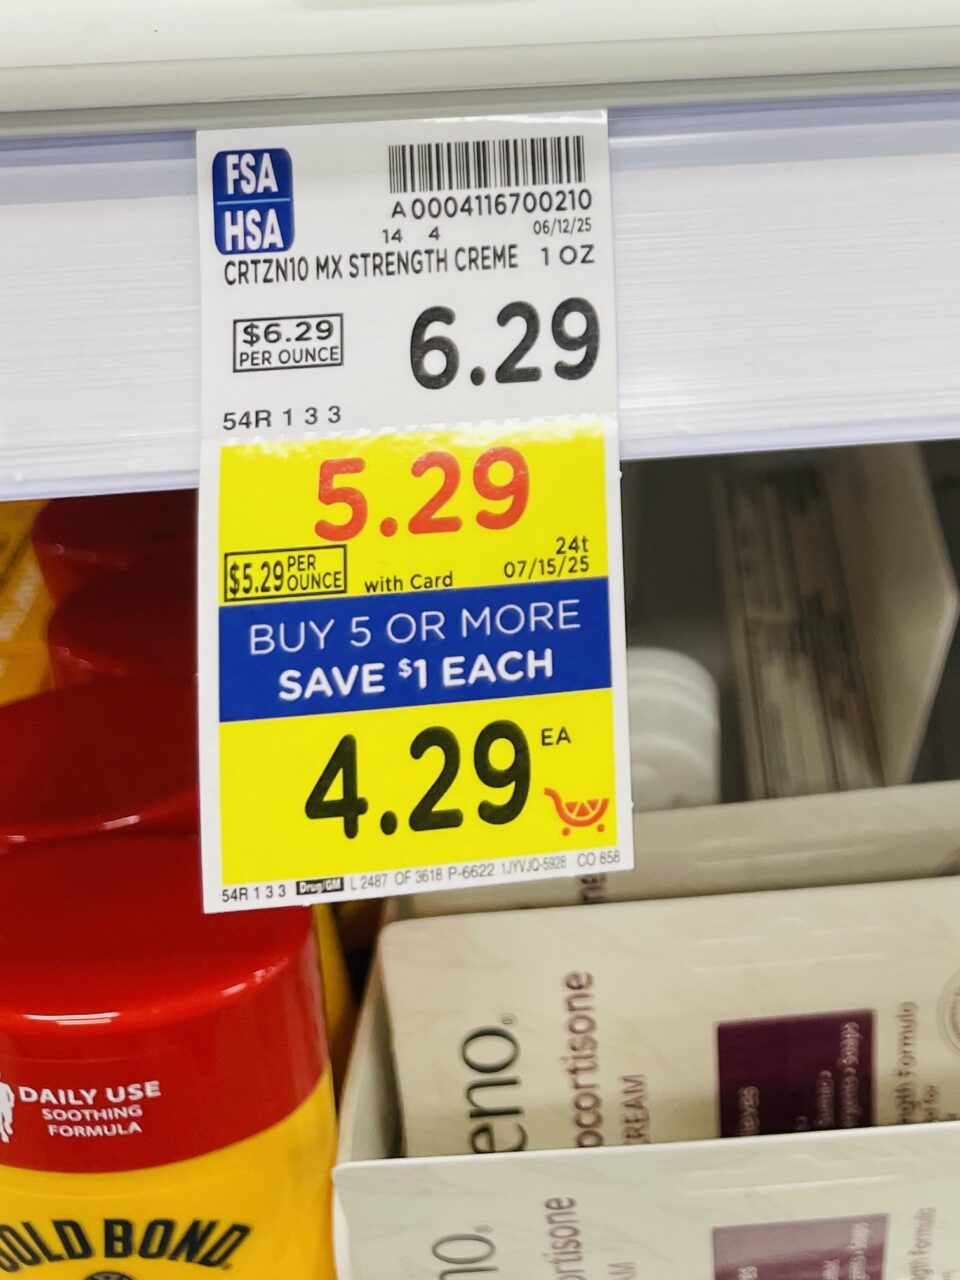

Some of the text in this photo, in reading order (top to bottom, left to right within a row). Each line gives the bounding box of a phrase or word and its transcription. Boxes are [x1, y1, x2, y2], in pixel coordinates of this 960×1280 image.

[226, 152, 279, 195] FSA
[224, 209, 284, 251] HSA
[382, 226, 441, 244] 14 4
[533, 217, 592, 236] 06/12/25
[224, 244, 595, 286] CRTZN10 MX STRENGTH CREME 1 OZ
[242, 320, 334, 348] $6.29
[410, 297, 600, 390] 6.29
[239, 346, 340, 367] PER OUNCE
[223, 405, 342, 431] 54R 1 3 3
[314, 446, 530, 542] 5.29
[555, 536, 589, 556] 24t
[229, 555, 342, 598] $5.29 PER OUNCE
[364, 571, 454, 593] with Card
[503, 556, 590, 580] 07/15/25
[250, 599, 582, 656] BUY 5 OR MORE
[278, 647, 554, 702] SAVE $1 EACH
[305, 719, 572, 840] 4.29 EA
[222, 886, 249, 903] 54R
[265, 885, 274, 899] 3
[278, 884, 287, 898] 3
[298, 877, 343, 895] Drug/GM
[361, 873, 389, 890] 2487
[394, 871, 412, 886] OF
[415, 867, 443, 884] 3618
[448, 862, 496, 880] P-6622
[577, 851, 596, 867] CO
[599, 849, 621, 865] 858
[18, 1080, 162, 1105] DAILY USE
[41, 1104, 143, 1122] SOOTHING
[48, 1121, 143, 1138] FORMULA
[0, 1218, 253, 1273] OLD BOND
